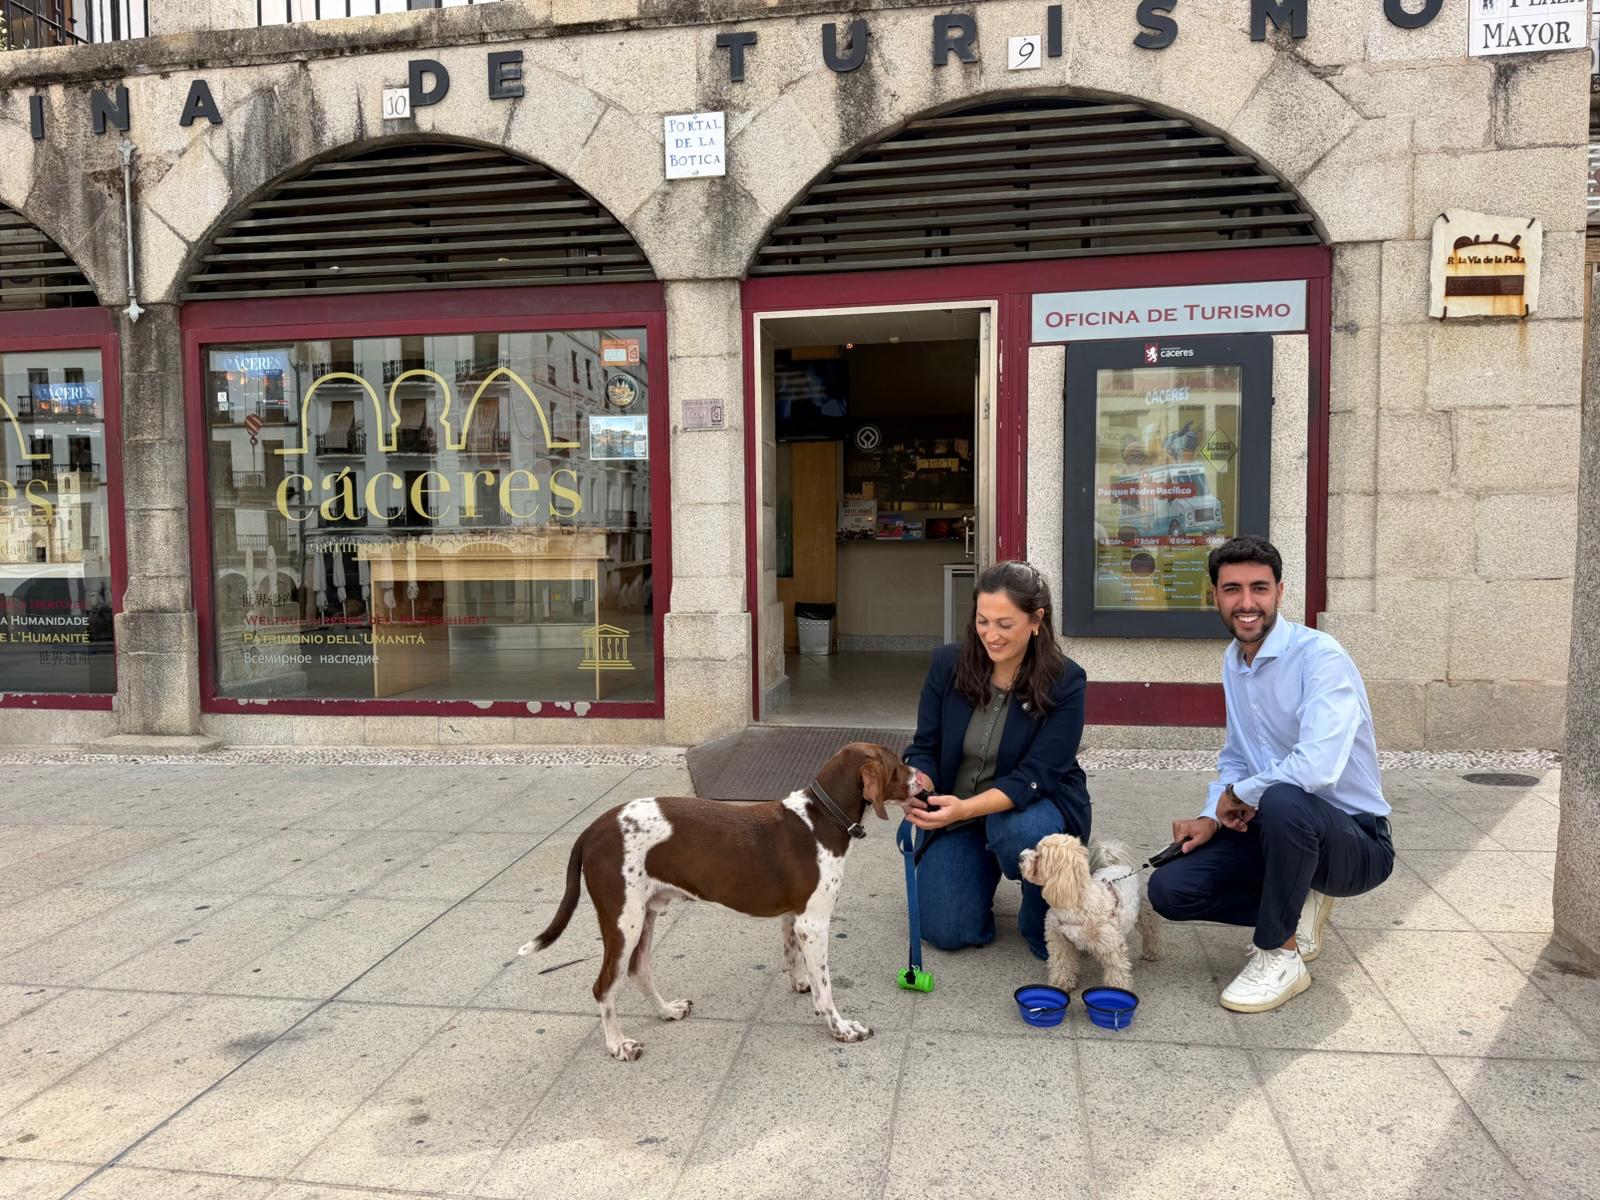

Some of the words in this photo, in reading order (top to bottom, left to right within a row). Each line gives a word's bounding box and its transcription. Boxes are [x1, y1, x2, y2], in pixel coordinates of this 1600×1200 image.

[1482, 20, 1572, 49] MAYOR
[1016, 41, 1035, 67] 9
[408, 50, 524, 108] DE
[668, 116, 722, 134] PORTAL
[675, 136, 693, 149] DE
[699, 135, 716, 148] LA
[670, 151, 721, 167] BOTICA
[1483, 255, 1493, 264] de
[1045, 309, 1141, 329] OFICINA
[1147, 307, 1178, 324] DE
[1183, 302, 1291, 322] TURISMO
[275, 466, 582, 522] cáceres
[1098, 487, 1129, 498] Parque
[1130, 486, 1156, 496] Padre
[1156, 486, 1192, 496] Pacífico
[11, 615, 90, 626] HUMANIDADE
[10, 630, 91, 644] L'HUMANITÉ
[244, 632, 324, 645] PATRIMONIO
[244, 652, 312, 665] Всемирное
[320, 653, 379, 667] наследие
